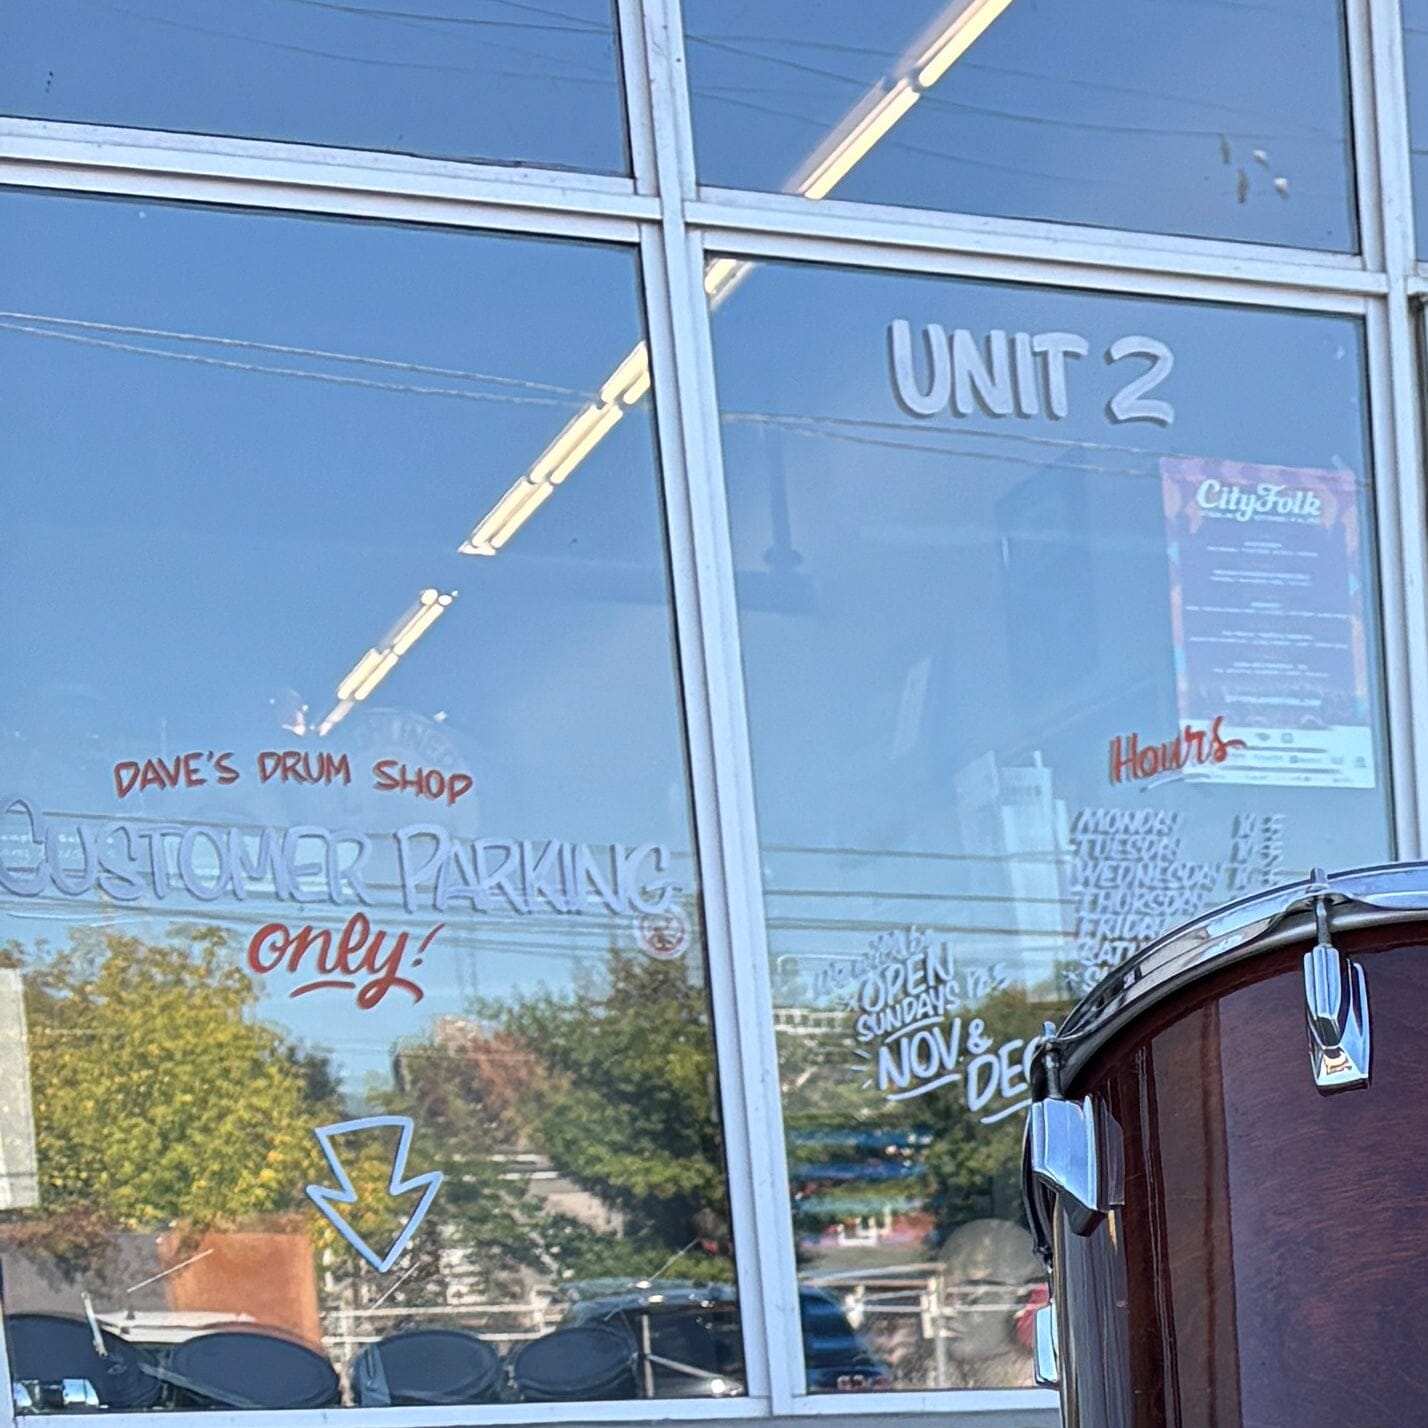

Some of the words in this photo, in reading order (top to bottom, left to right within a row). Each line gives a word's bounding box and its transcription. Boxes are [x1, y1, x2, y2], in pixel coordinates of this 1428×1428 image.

[890, 319, 1088, 418] UNIT
[1107, 336, 1174, 425] 2
[114, 751, 241, 797] DAVE'S
[257, 751, 351, 785] DRUM
[373, 760, 472, 805] SHOP
[1110, 715, 1247, 784] Hours
[0, 800, 375, 904] CUSTOMER
[394, 824, 682, 915] PARKING
[247, 912, 446, 1009] only!
[860, 948, 954, 1012] OPEN
[857, 980, 961, 1042] SUNDAYS
[967, 1018, 993, 1054] &
